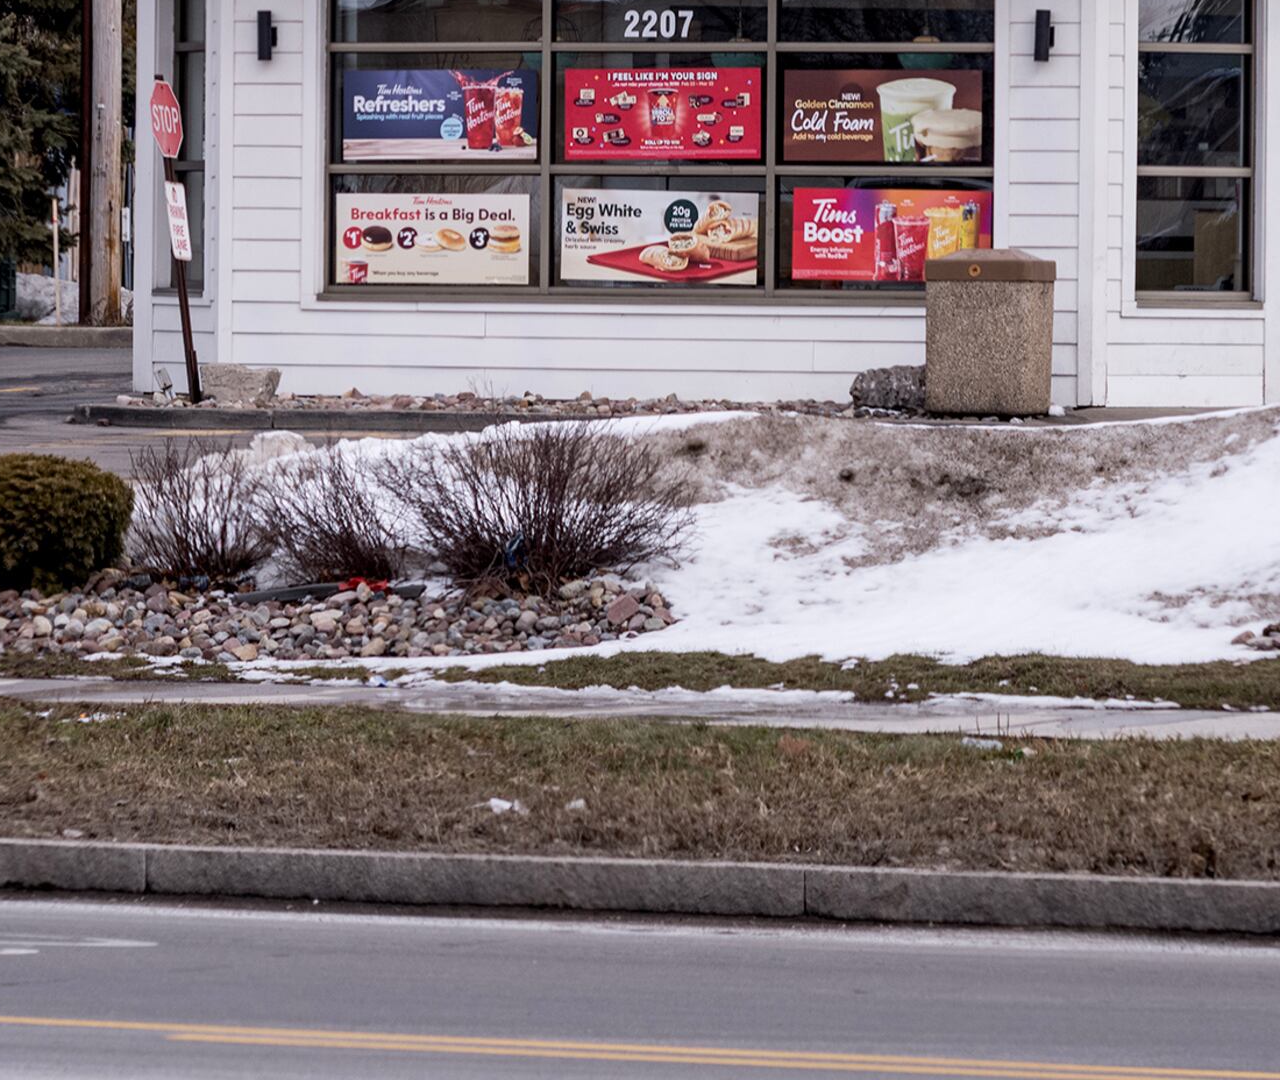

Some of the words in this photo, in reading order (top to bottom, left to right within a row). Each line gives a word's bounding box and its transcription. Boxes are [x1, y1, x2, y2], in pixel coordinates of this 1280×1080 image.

[624, 9, 694, 38] 2207
[613, 72, 633, 81] FEEL
[635, 72, 654, 81] LIKE
[655, 72, 669, 81] I'M
[670, 72, 694, 81] YOUR
[696, 72, 718, 81] SIGN
[353, 95, 446, 113] Refreshers
[795, 99, 827, 109] Golden
[828, 99, 874, 109] Cinnamon
[841, 93, 861, 101] NEW!
[466, 98, 485, 114] Tim
[152, 104, 179, 134] STOP
[791, 109, 828, 132] Cold
[833, 111, 874, 132] Foam
[842, 133, 874, 141] beverage
[577, 196, 597, 204] NEW!
[351, 208, 421, 221] Breakfast
[424, 208, 435, 220] is
[439, 211, 448, 220] a
[452, 208, 474, 223] Big
[478, 208, 516, 221] Deal.
[566, 203, 594, 220] Egg
[599, 204, 642, 218] White
[672, 206, 691, 218] 20g
[812, 198, 857, 224] Tims
[566, 220, 576, 234] &
[580, 221, 619, 235] Swiss
[804, 221, 864, 243] Boost
